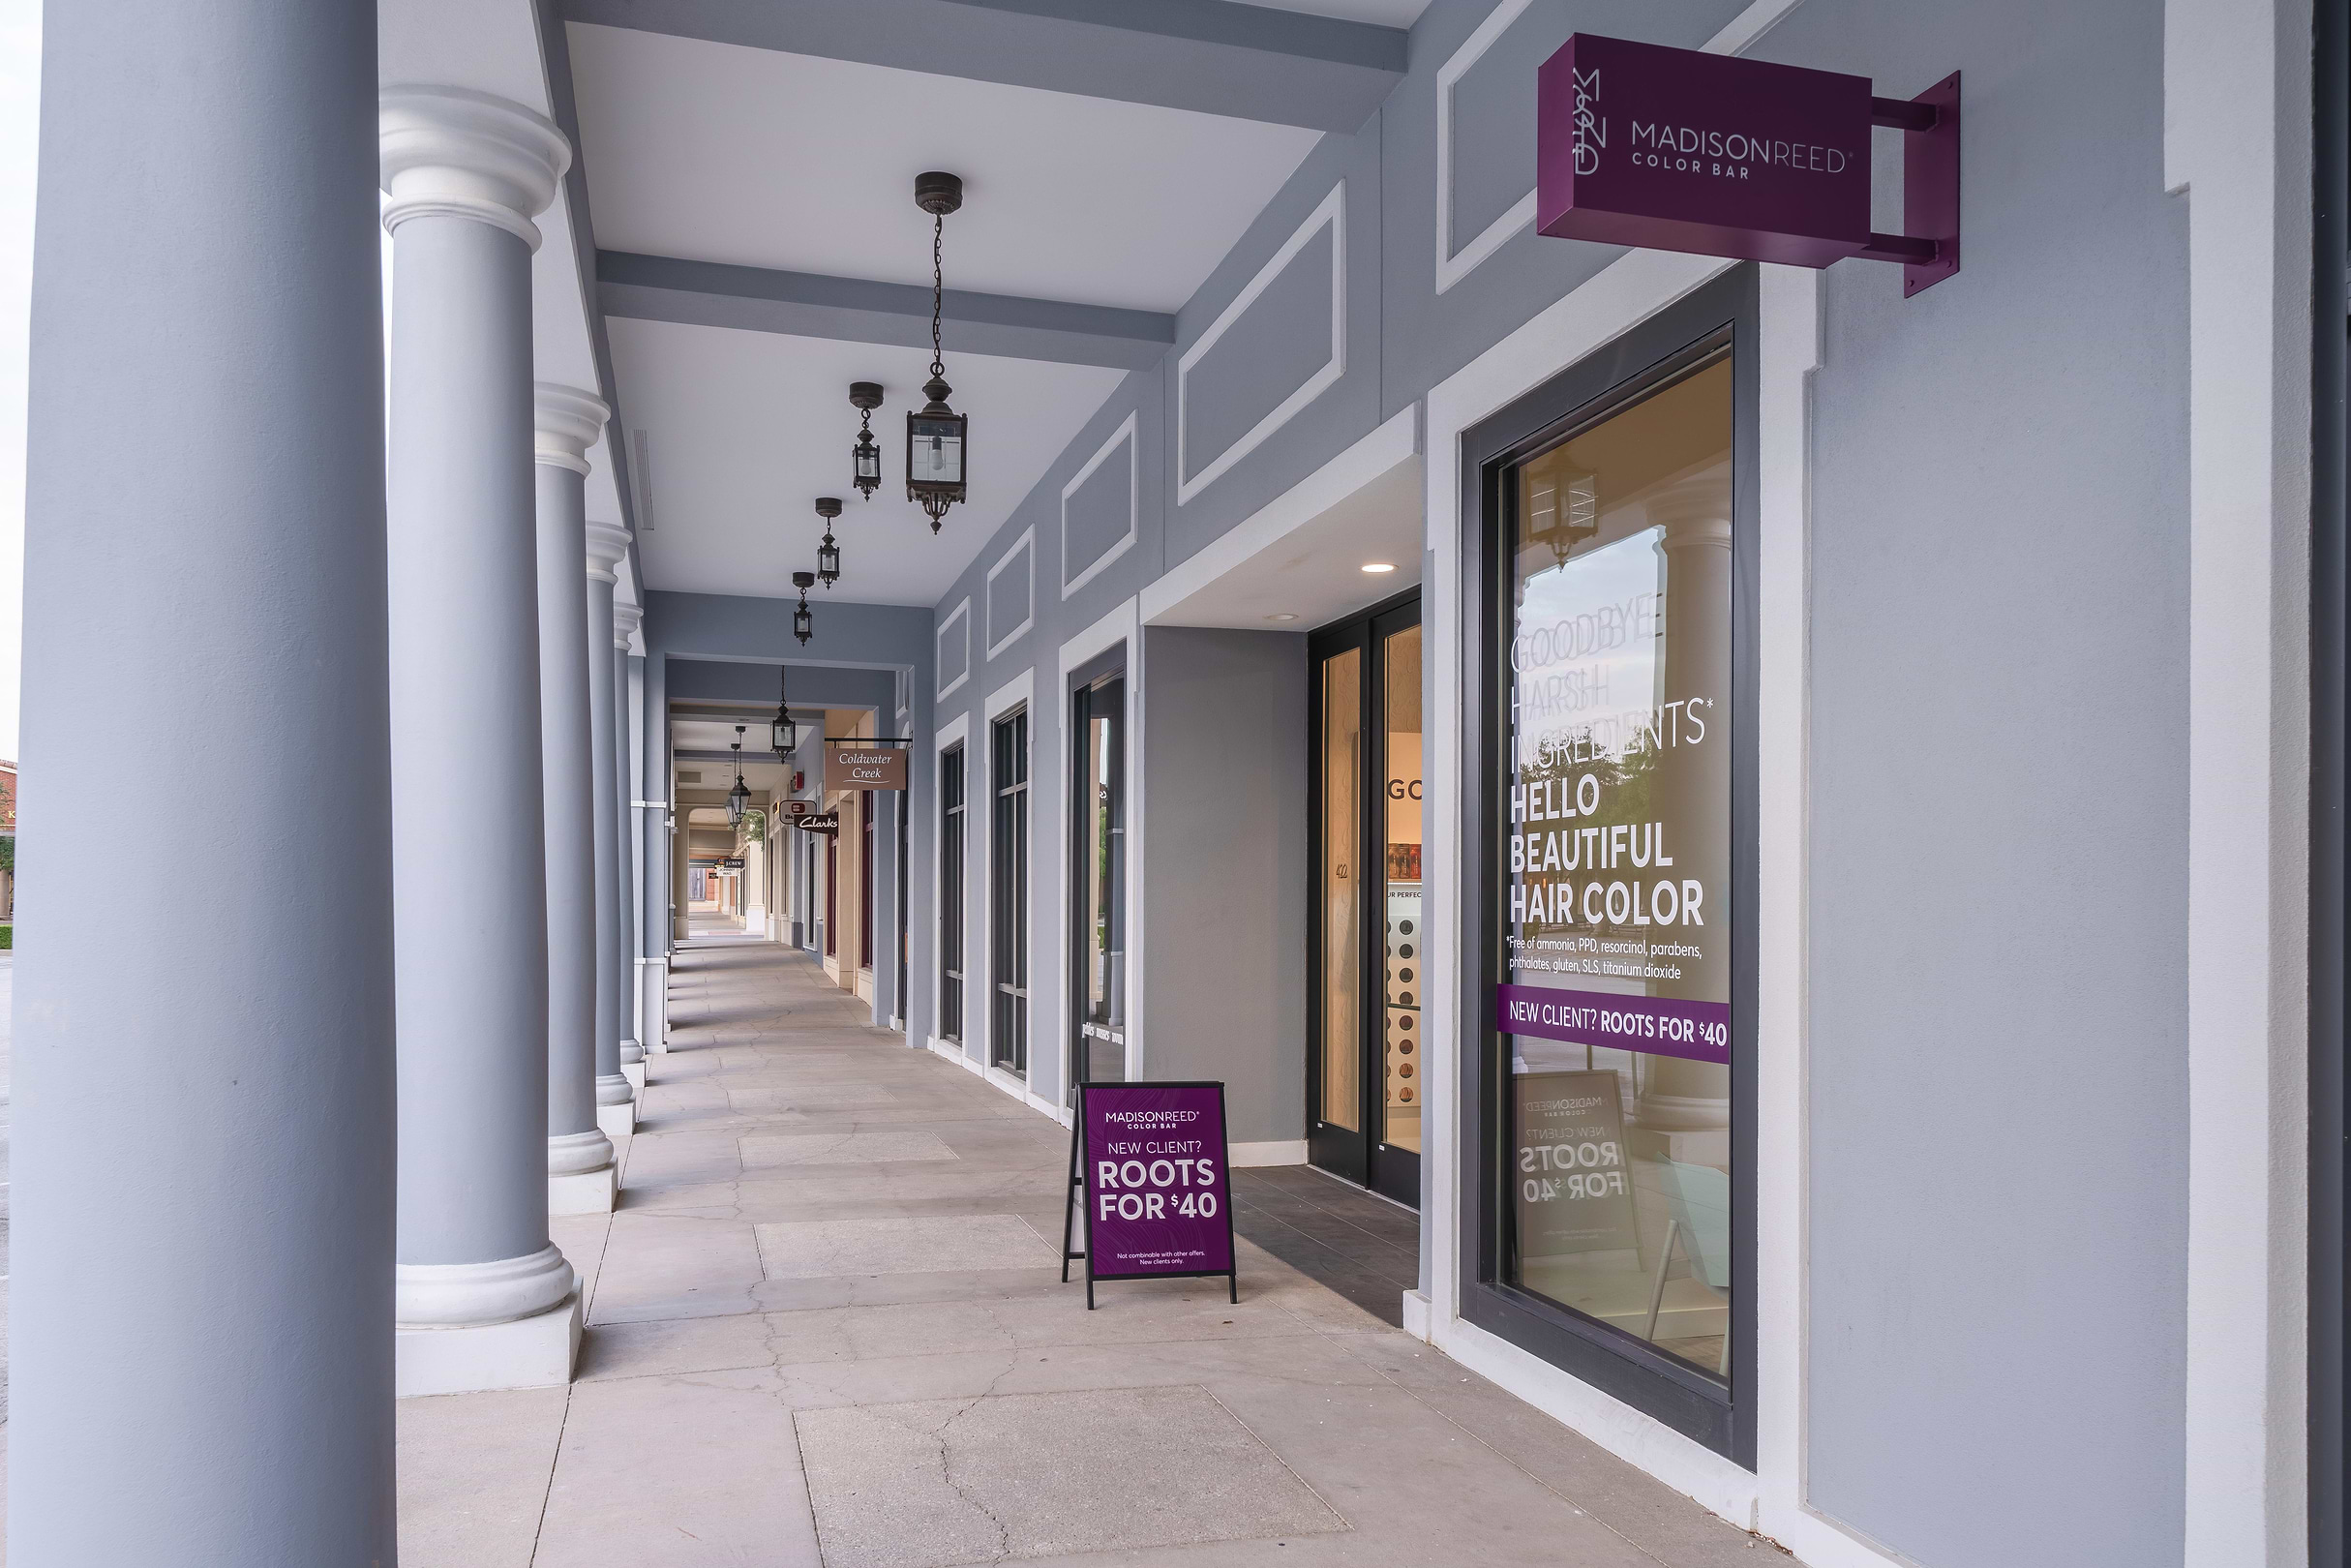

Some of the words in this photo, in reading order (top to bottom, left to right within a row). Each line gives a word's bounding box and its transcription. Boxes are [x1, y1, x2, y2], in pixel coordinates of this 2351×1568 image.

[1632, 152, 1701, 173] COLOR
[1712, 163, 1749, 180] BAR
[1511, 591, 1655, 674] GOODBYE
[1511, 664, 1602, 725] HARSH
[838, 753, 892, 765] Coldwater
[852, 767, 882, 778] Creek
[1511, 773, 1600, 824] HELLO
[799, 816, 838, 829] Clarks
[1510, 822, 1673, 874] BEAUTIFUL
[1510, 882, 1574, 923] HAIR
[1582, 879, 1704, 926] COLOR
[1526, 936, 1536, 950] of
[1536, 938, 1577, 952] ammonia,
[1579, 937, 1599, 954] PPD,
[1601, 939, 1648, 956] resorcinol,
[1650, 940, 1703, 960] parabens,
[1509, 955, 1552, 972] phthalates,
[1552, 957, 1581, 974] gluten,
[1582, 958, 1601, 976] SLS,
[1603, 960, 1643, 977] titanium
[1643, 962, 1681, 980] dioxide
[1509, 1000, 1540, 1023] NEW
[1542, 1004, 1597, 1031] CLIENT?
[1600, 1010, 1655, 1038] ROOTS
[1659, 1015, 1695, 1043] FOR
[1699, 1021, 1728, 1047] $40
[1108, 1141, 1142, 1155] NEW
[1146, 1139, 1202, 1154] CLIENT?
[1098, 1159, 1216, 1189] ROOTS
[1100, 1192, 1166, 1221] FOR
[1170, 1191, 1218, 1219] $40
